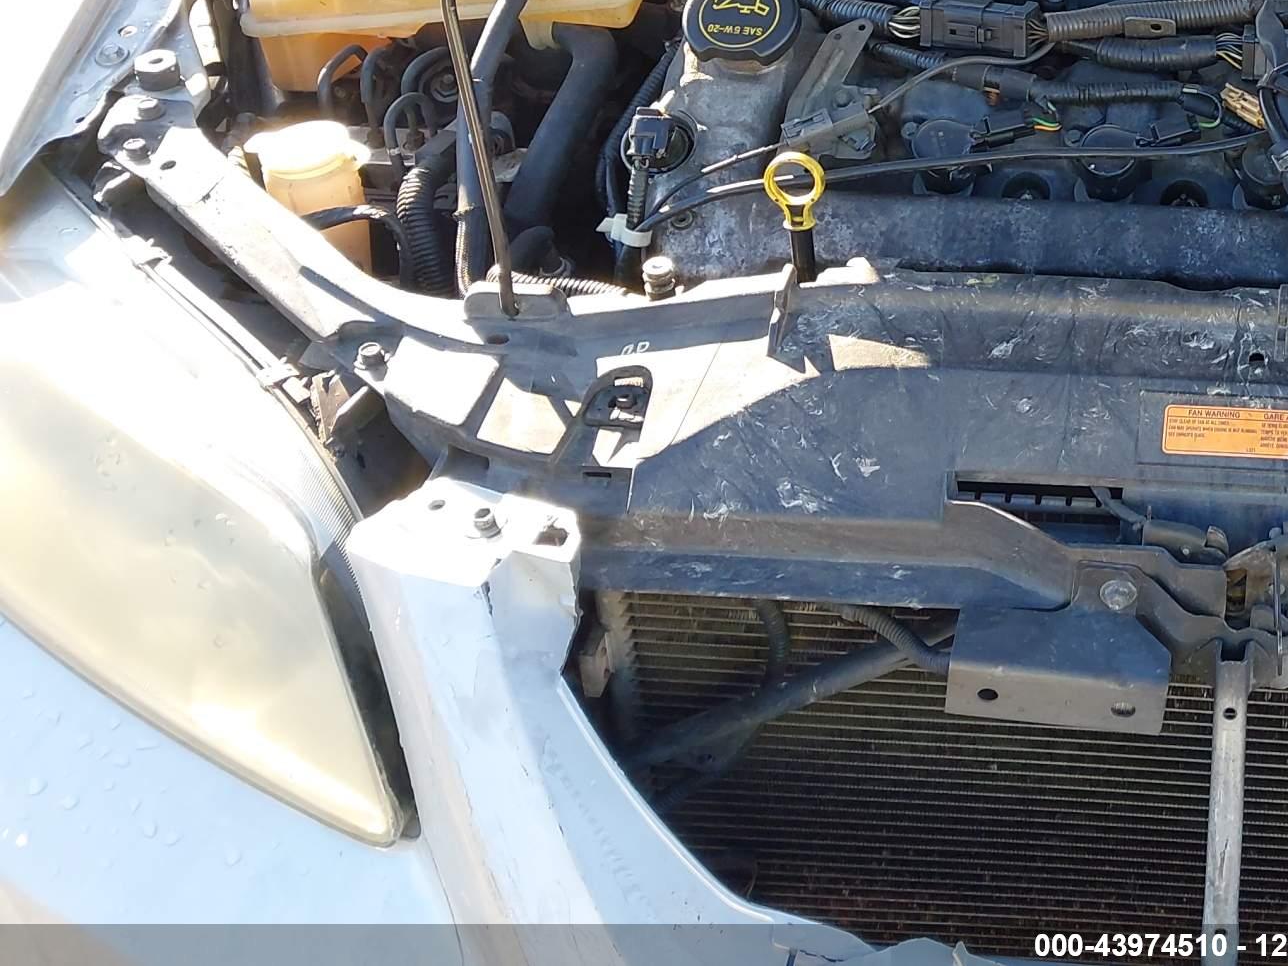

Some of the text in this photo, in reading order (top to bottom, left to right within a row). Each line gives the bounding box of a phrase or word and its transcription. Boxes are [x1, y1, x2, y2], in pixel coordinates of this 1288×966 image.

[707, 23, 763, 36] SAE 5W-20
[1204, 409, 1240, 419] WARNING
[1263, 413, 1284, 421] GARE
